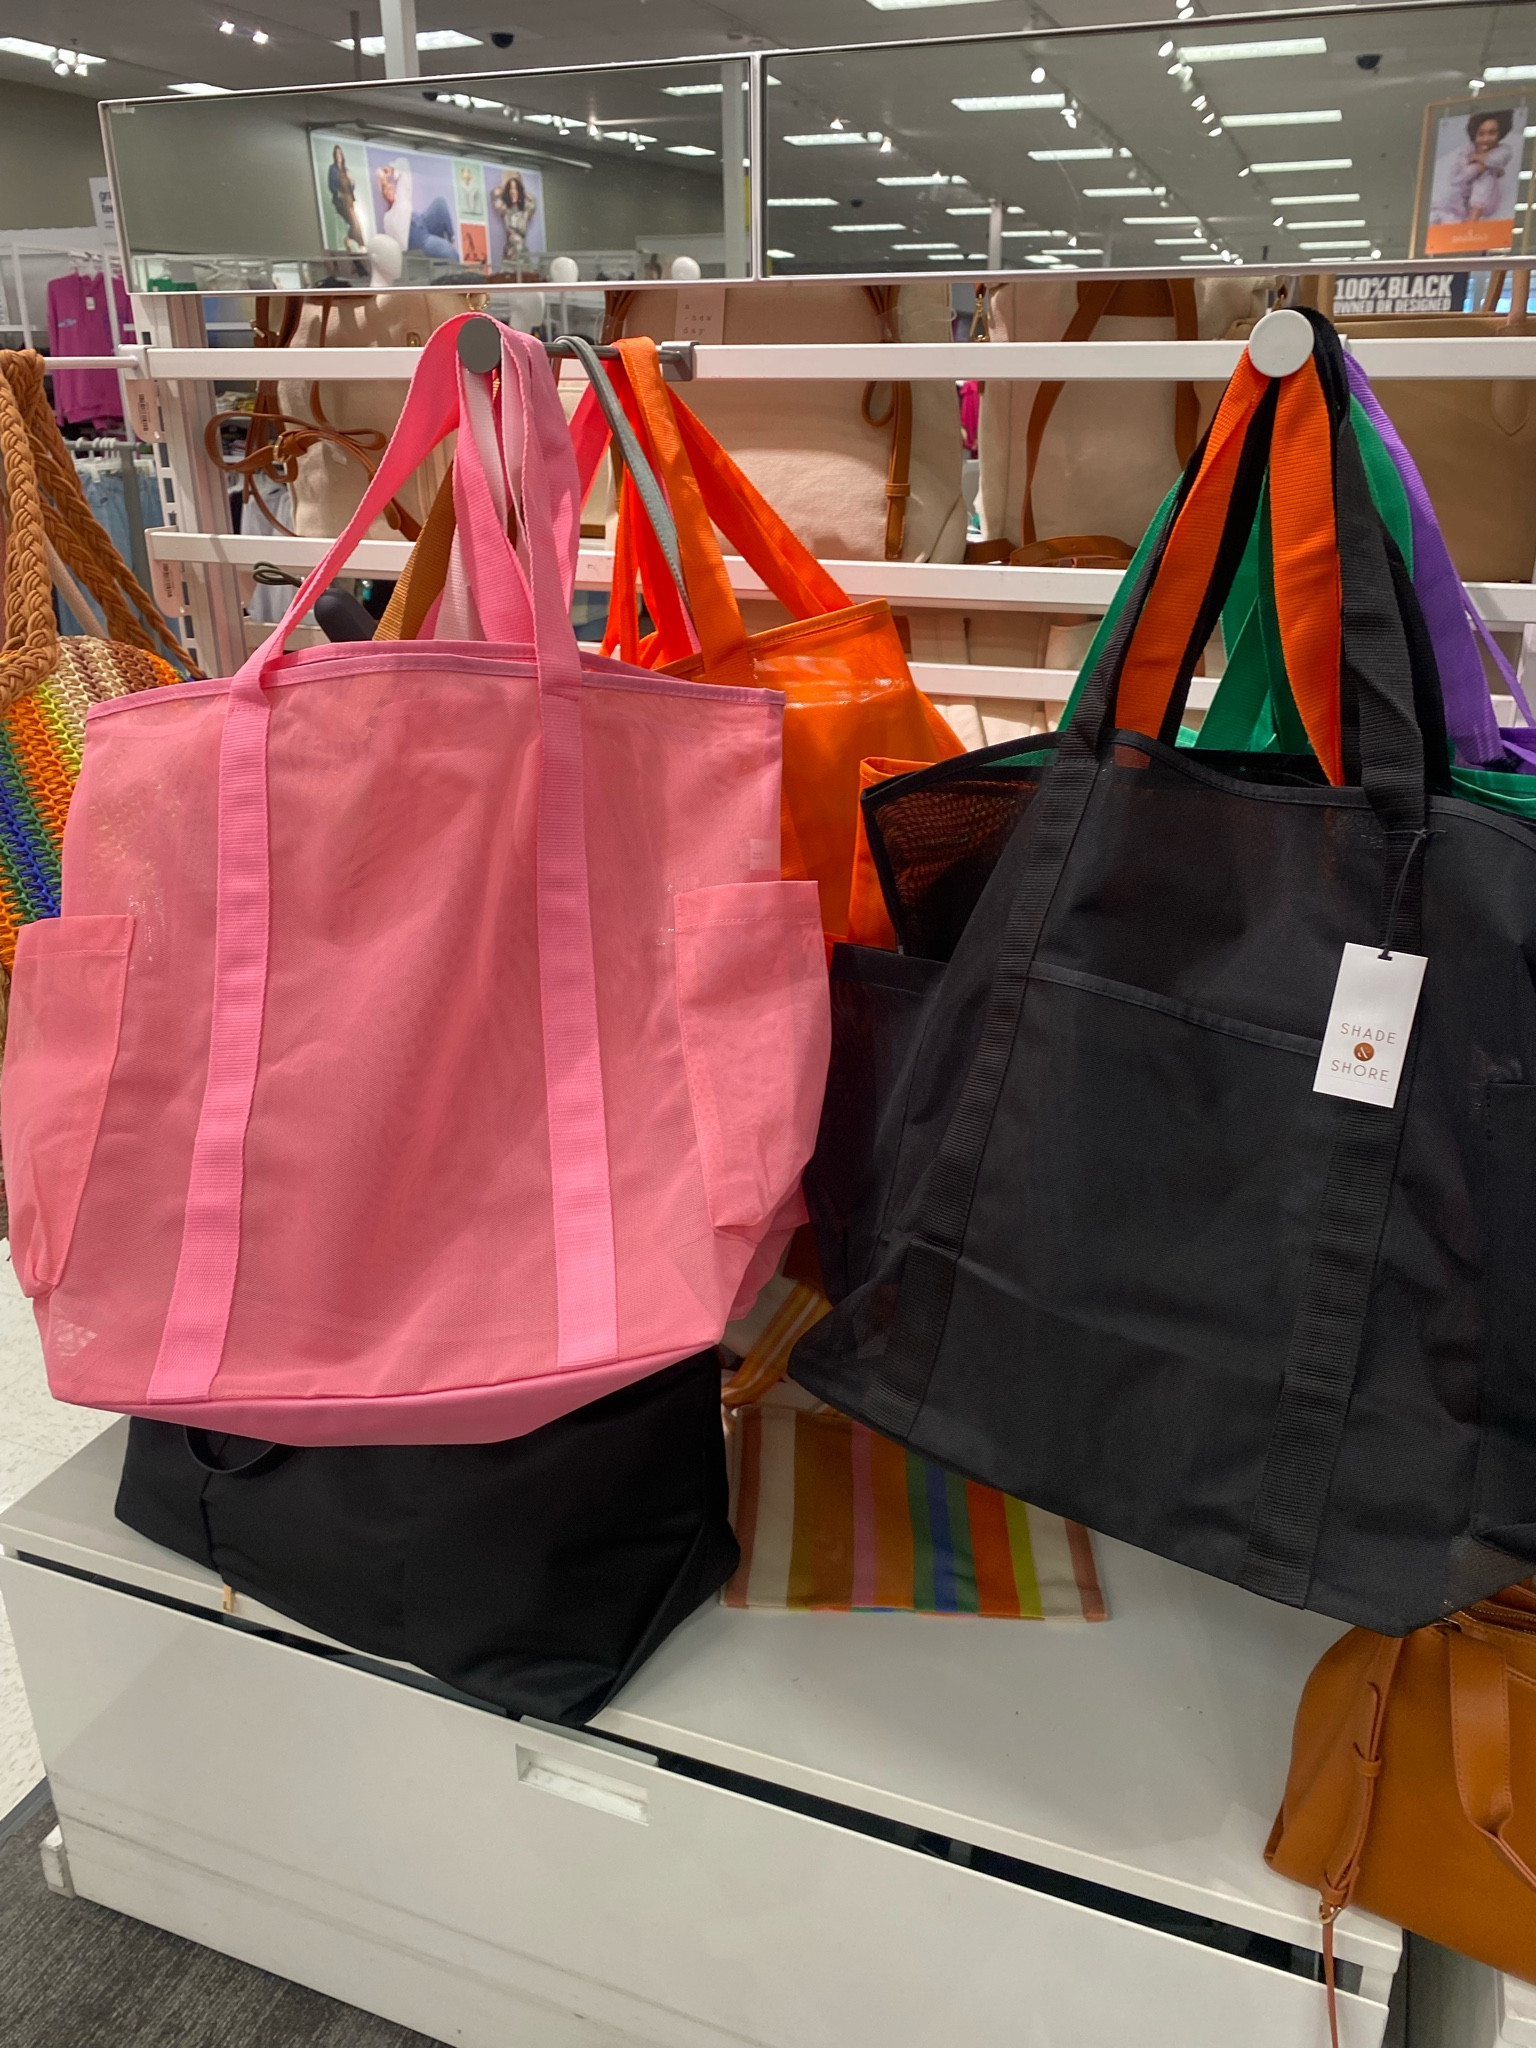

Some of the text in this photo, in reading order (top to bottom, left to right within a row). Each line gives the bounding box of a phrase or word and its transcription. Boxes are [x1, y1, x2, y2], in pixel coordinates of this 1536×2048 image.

[1333, 274, 1454, 300] 100% BLACK
[1375, 299, 1392, 313] OR
[1394, 297, 1452, 313] DESIGNED
[1340, 1022, 1397, 1044] SHADE
[1356, 1045, 1371, 1060] &
[1330, 1060, 1390, 1082] SHORE
